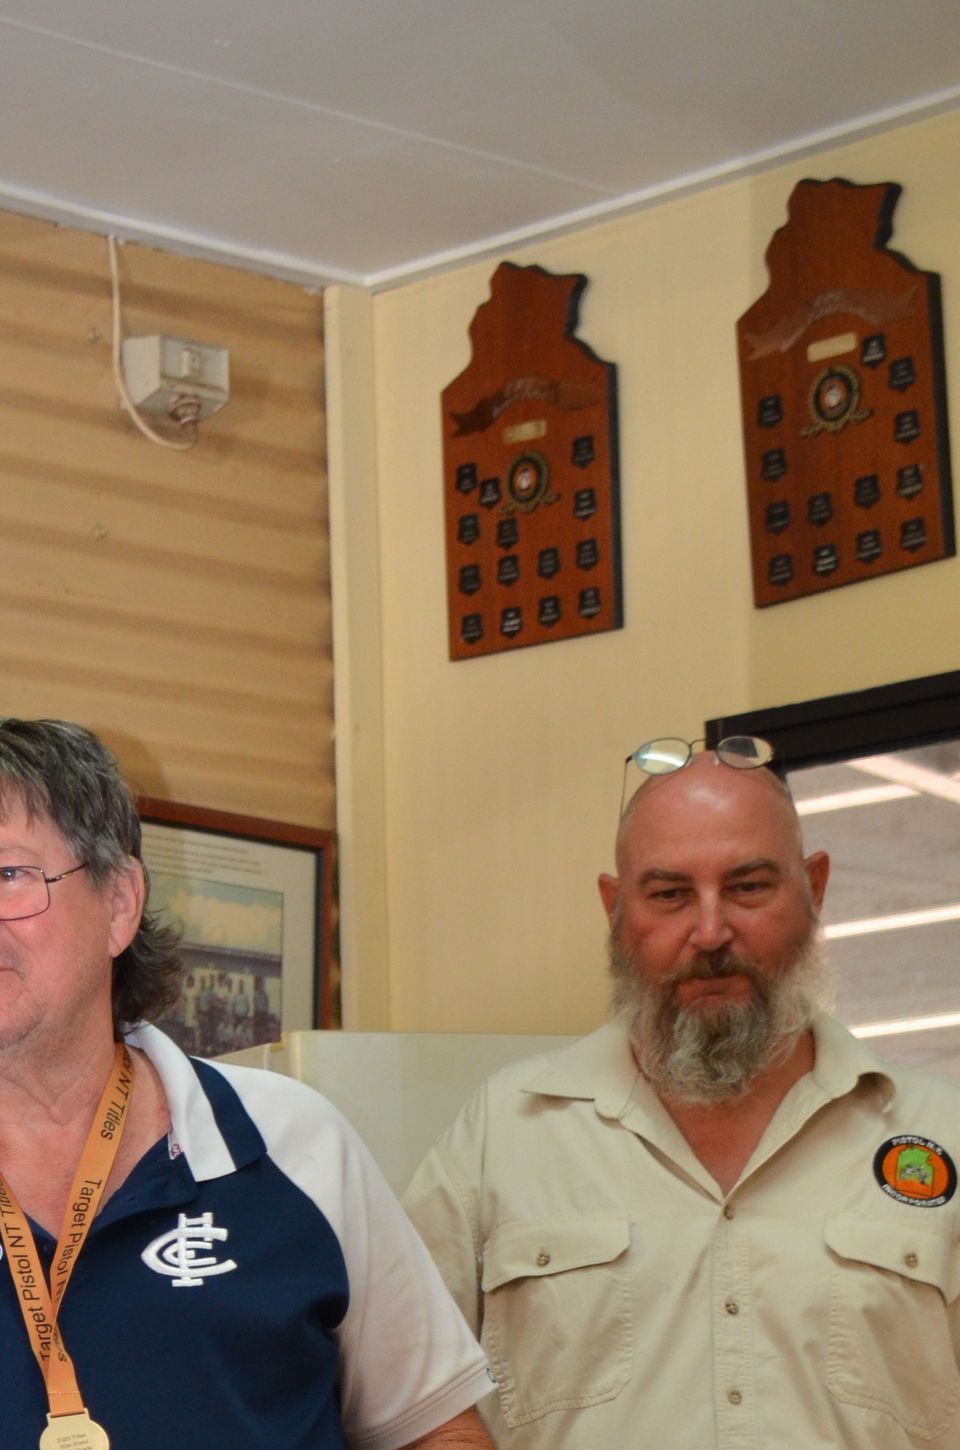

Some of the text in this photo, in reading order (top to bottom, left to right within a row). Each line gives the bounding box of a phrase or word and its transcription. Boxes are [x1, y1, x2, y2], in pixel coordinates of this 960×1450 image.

[101, 1101, 126, 1140] Titles
[70, 1178, 102, 1229] Target
[4, 1223, 26, 1249] NT
[56, 1232, 83, 1277] Pistol
[12, 1253, 40, 1301] Pistol
[27, 1307, 53, 1361] Target
